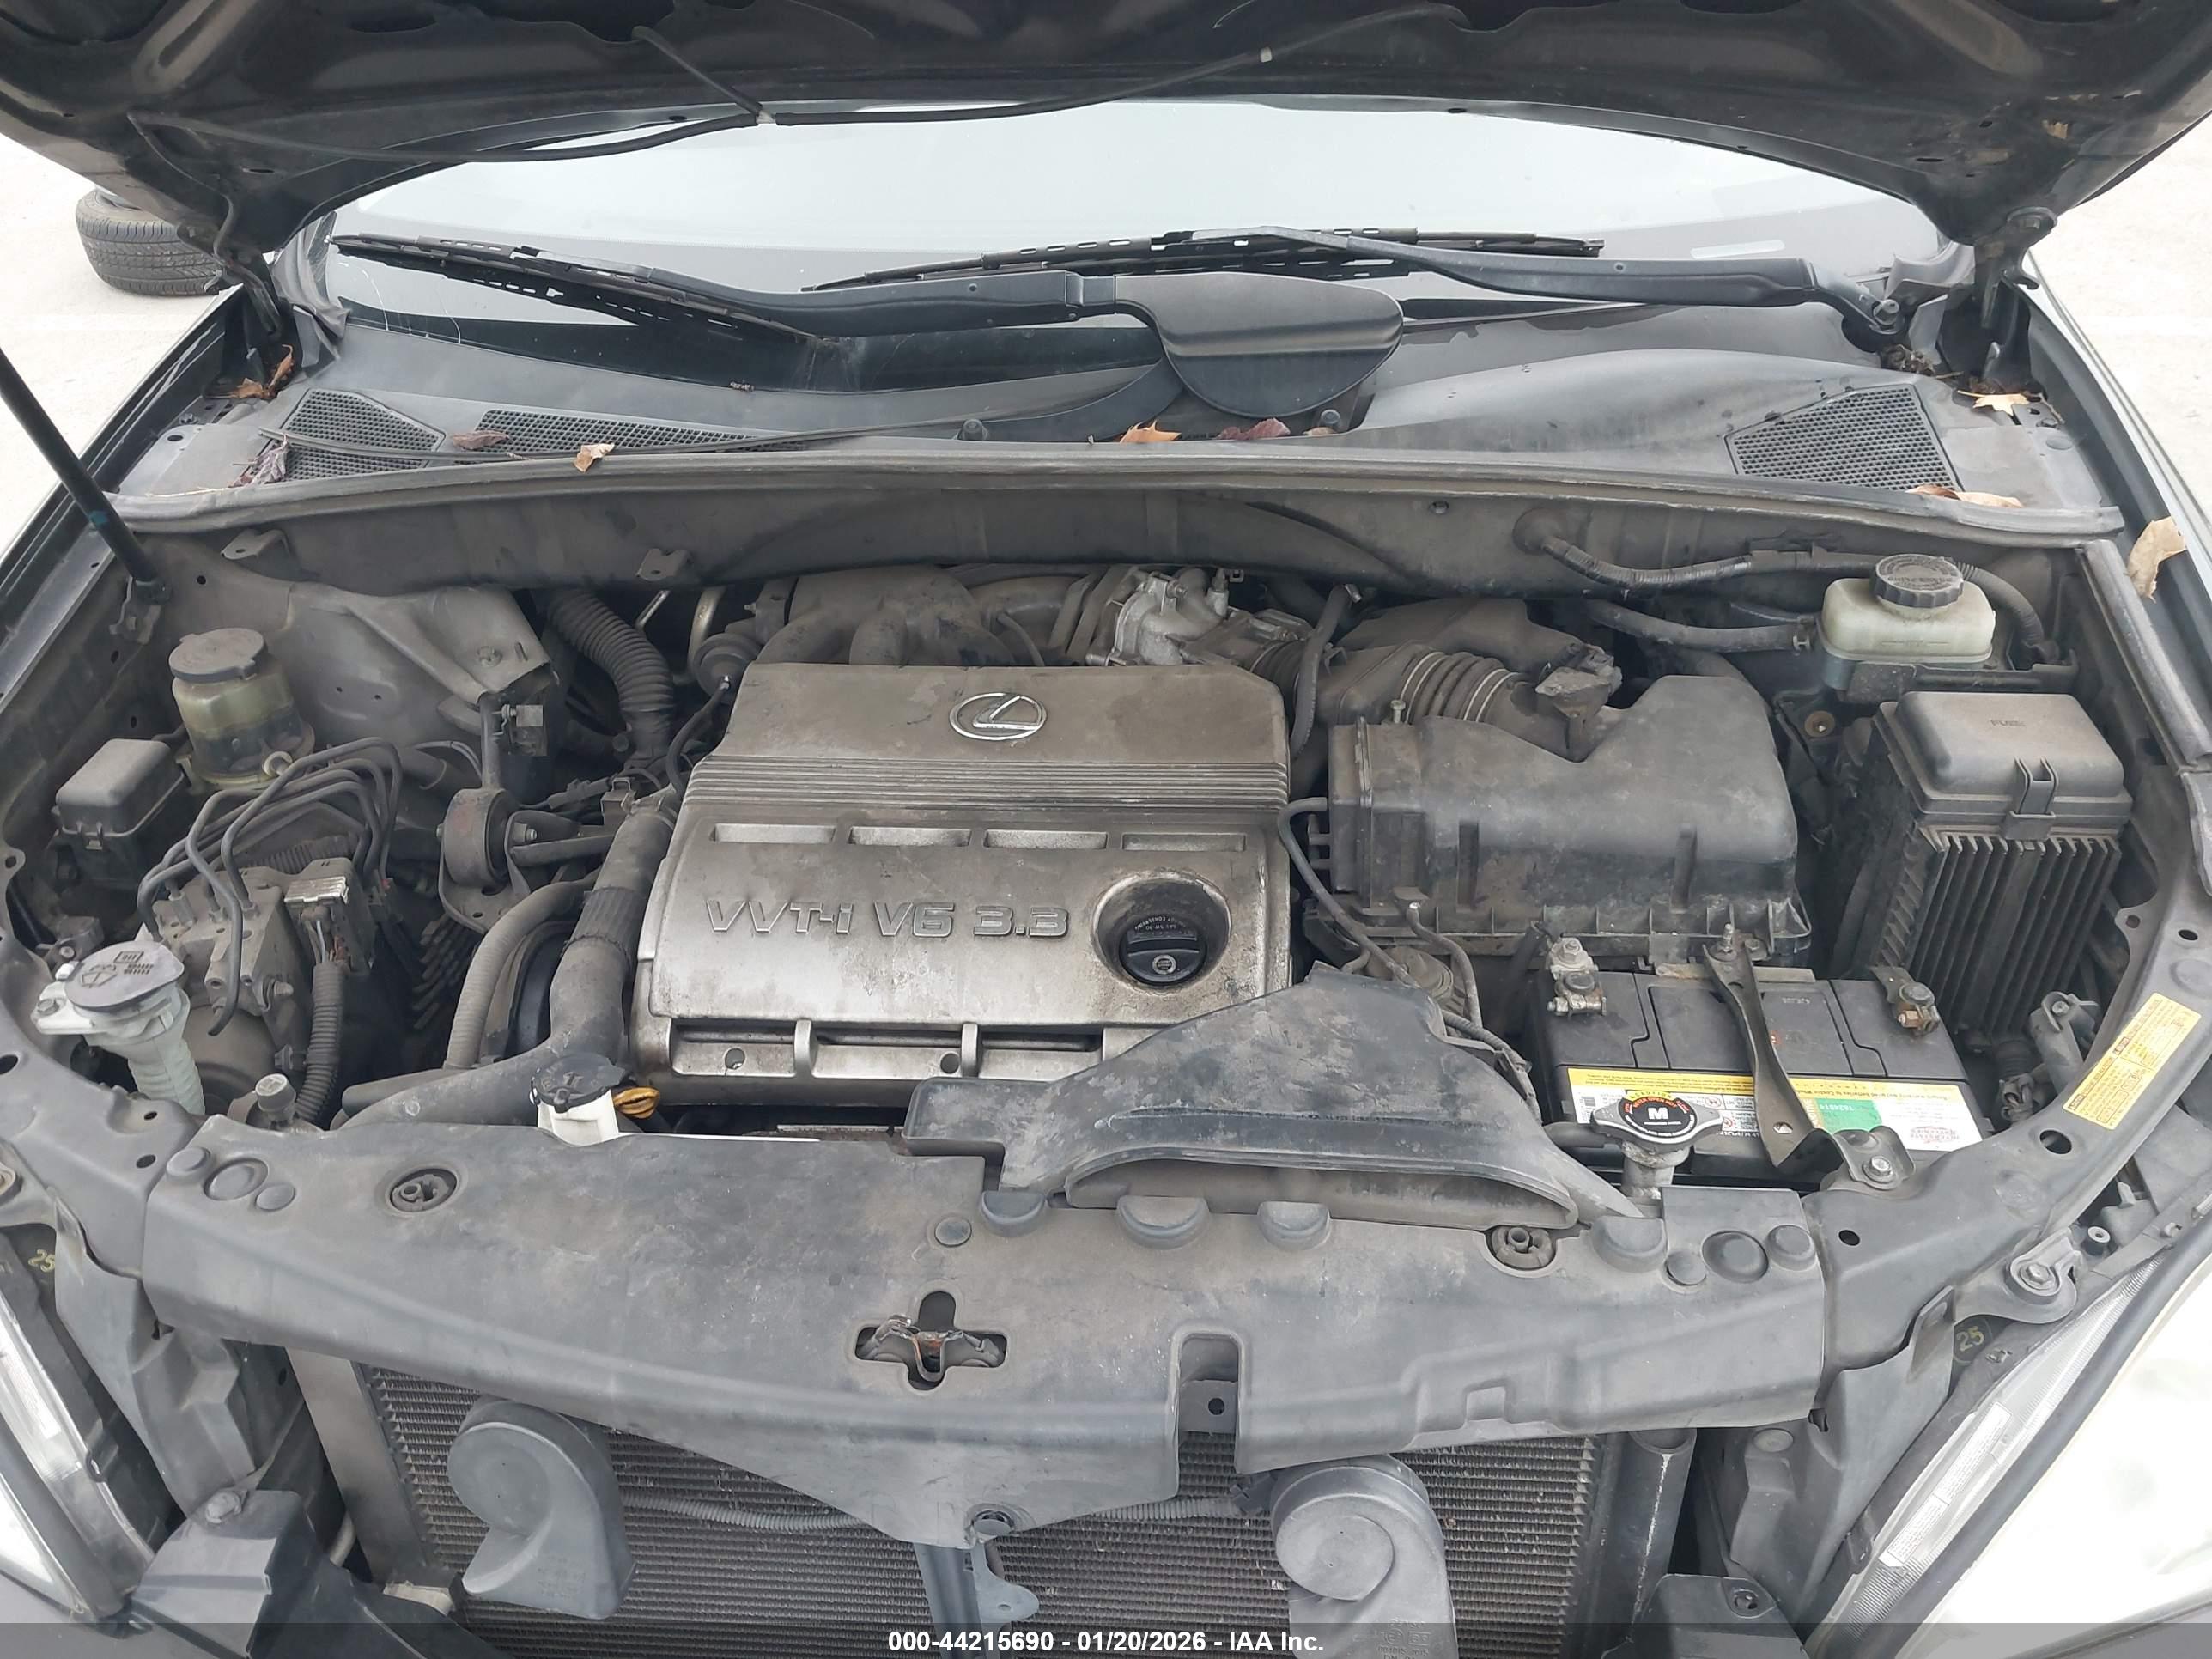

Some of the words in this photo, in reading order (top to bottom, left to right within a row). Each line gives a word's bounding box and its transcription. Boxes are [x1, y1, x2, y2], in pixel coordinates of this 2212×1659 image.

[874, 902, 956, 938] V6
[973, 904, 1070, 938] 3.3
[1647, 1107, 1668, 1120] M
[1956, 1325, 1984, 1352] 25
